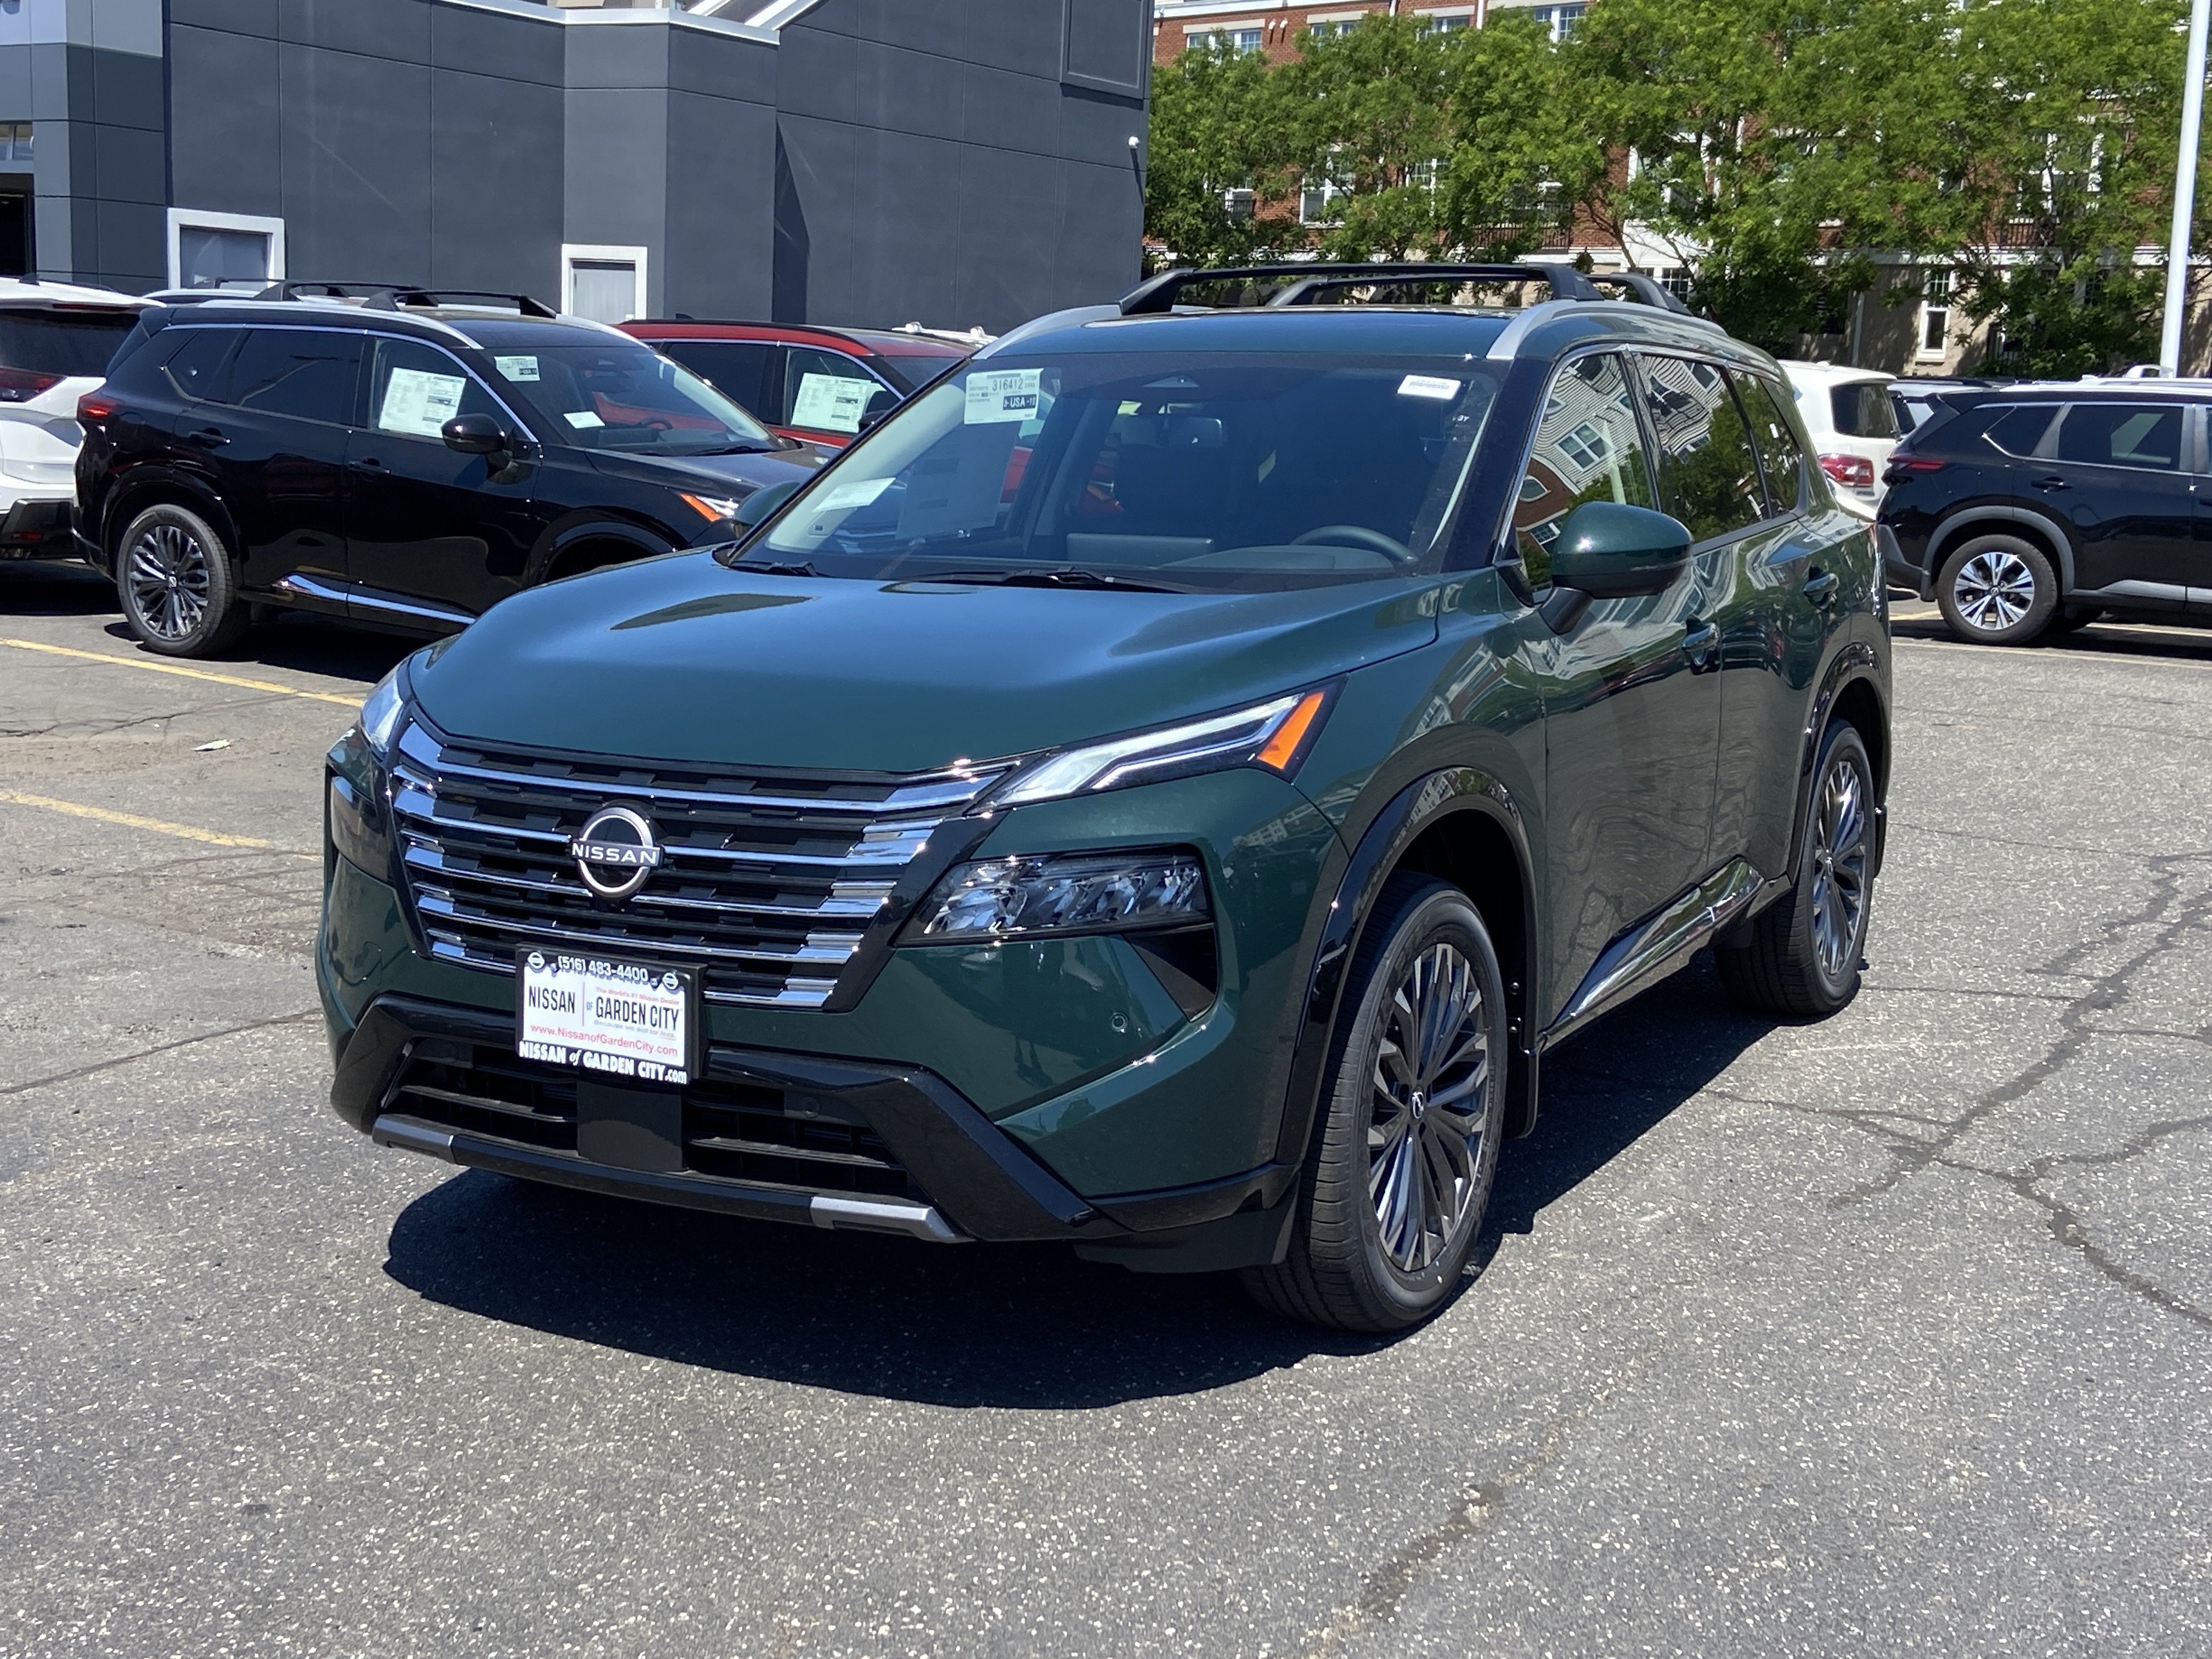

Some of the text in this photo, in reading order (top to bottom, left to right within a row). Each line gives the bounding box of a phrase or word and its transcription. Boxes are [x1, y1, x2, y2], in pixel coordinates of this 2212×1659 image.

[992, 378, 1024, 391] 316412
[1010, 397, 1025, 408] USA
[572, 843, 657, 864] NISSAN
[557, 955, 649, 982] (516) 483-4400
[528, 985, 575, 1014] NISSAN
[596, 996, 646, 1025] GARDEN
[650, 1005, 679, 1031] CITY
[531, 1023, 678, 1057] www.NissanofGardenCity.com
[518, 1041, 687, 1085] NISSAN of GARDEN CITY.com
